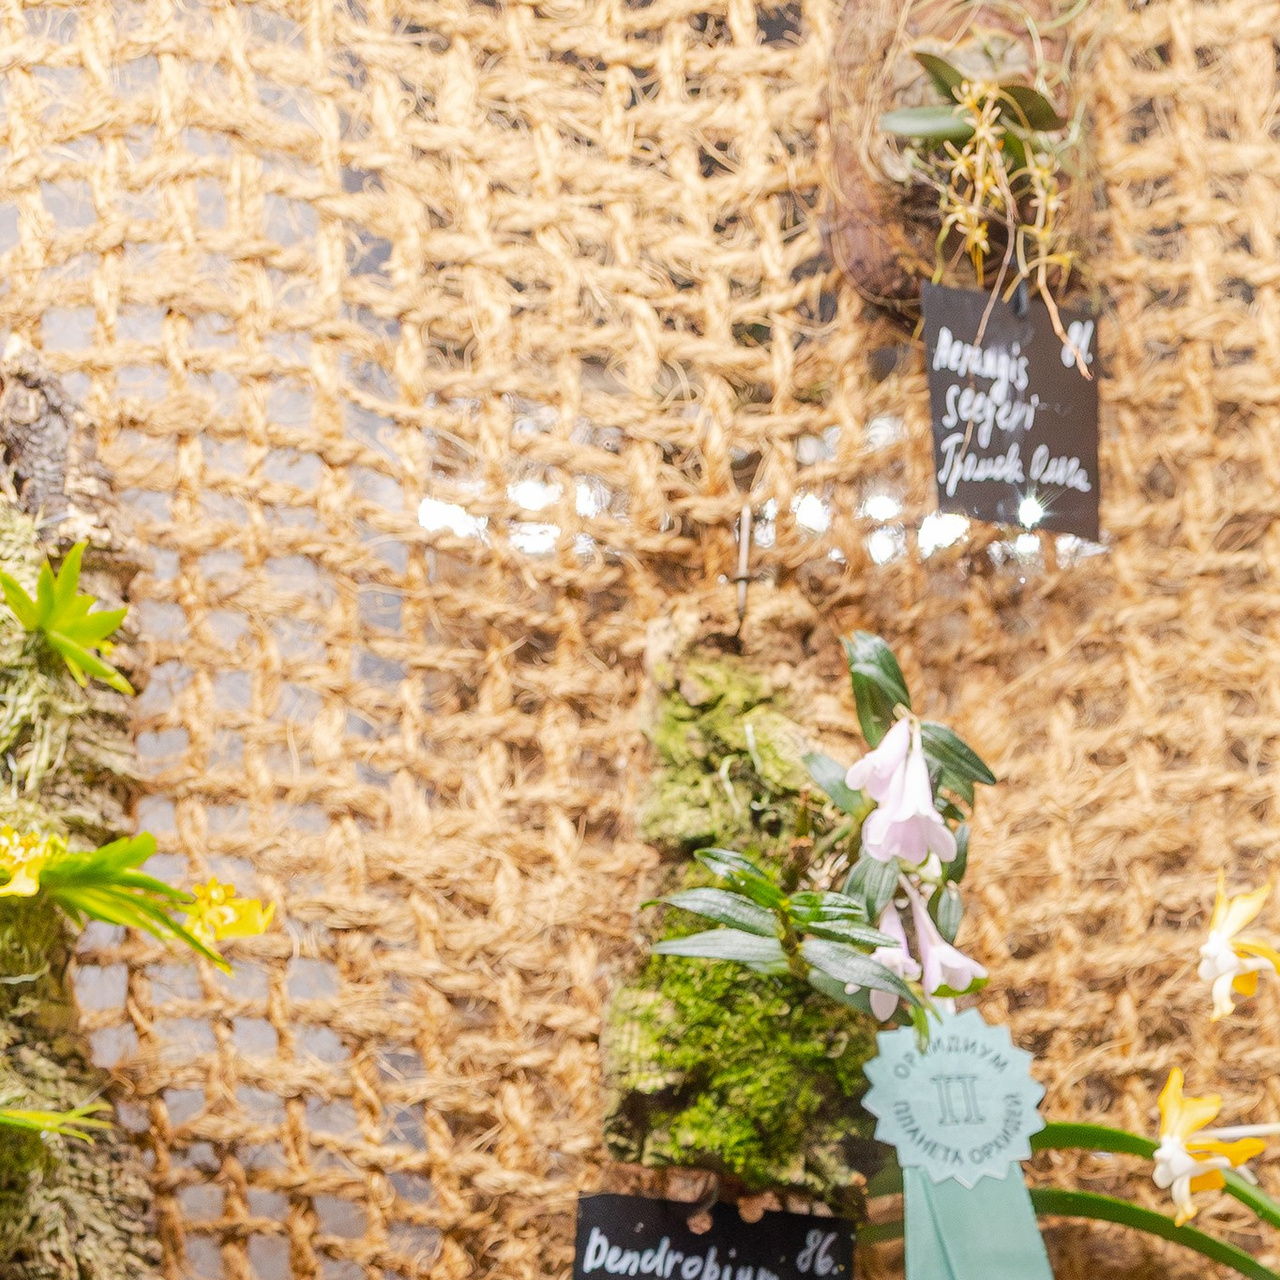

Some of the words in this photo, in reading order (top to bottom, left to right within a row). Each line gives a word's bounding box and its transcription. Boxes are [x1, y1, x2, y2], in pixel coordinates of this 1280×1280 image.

[893, 1035, 1008, 1079] ОРИДИУМ
[930, 1074, 986, 1126] II
[893, 1101, 964, 1166] ПЛАНЕТА
[968, 1092, 1023, 1164] ОРХИДЕЙ
